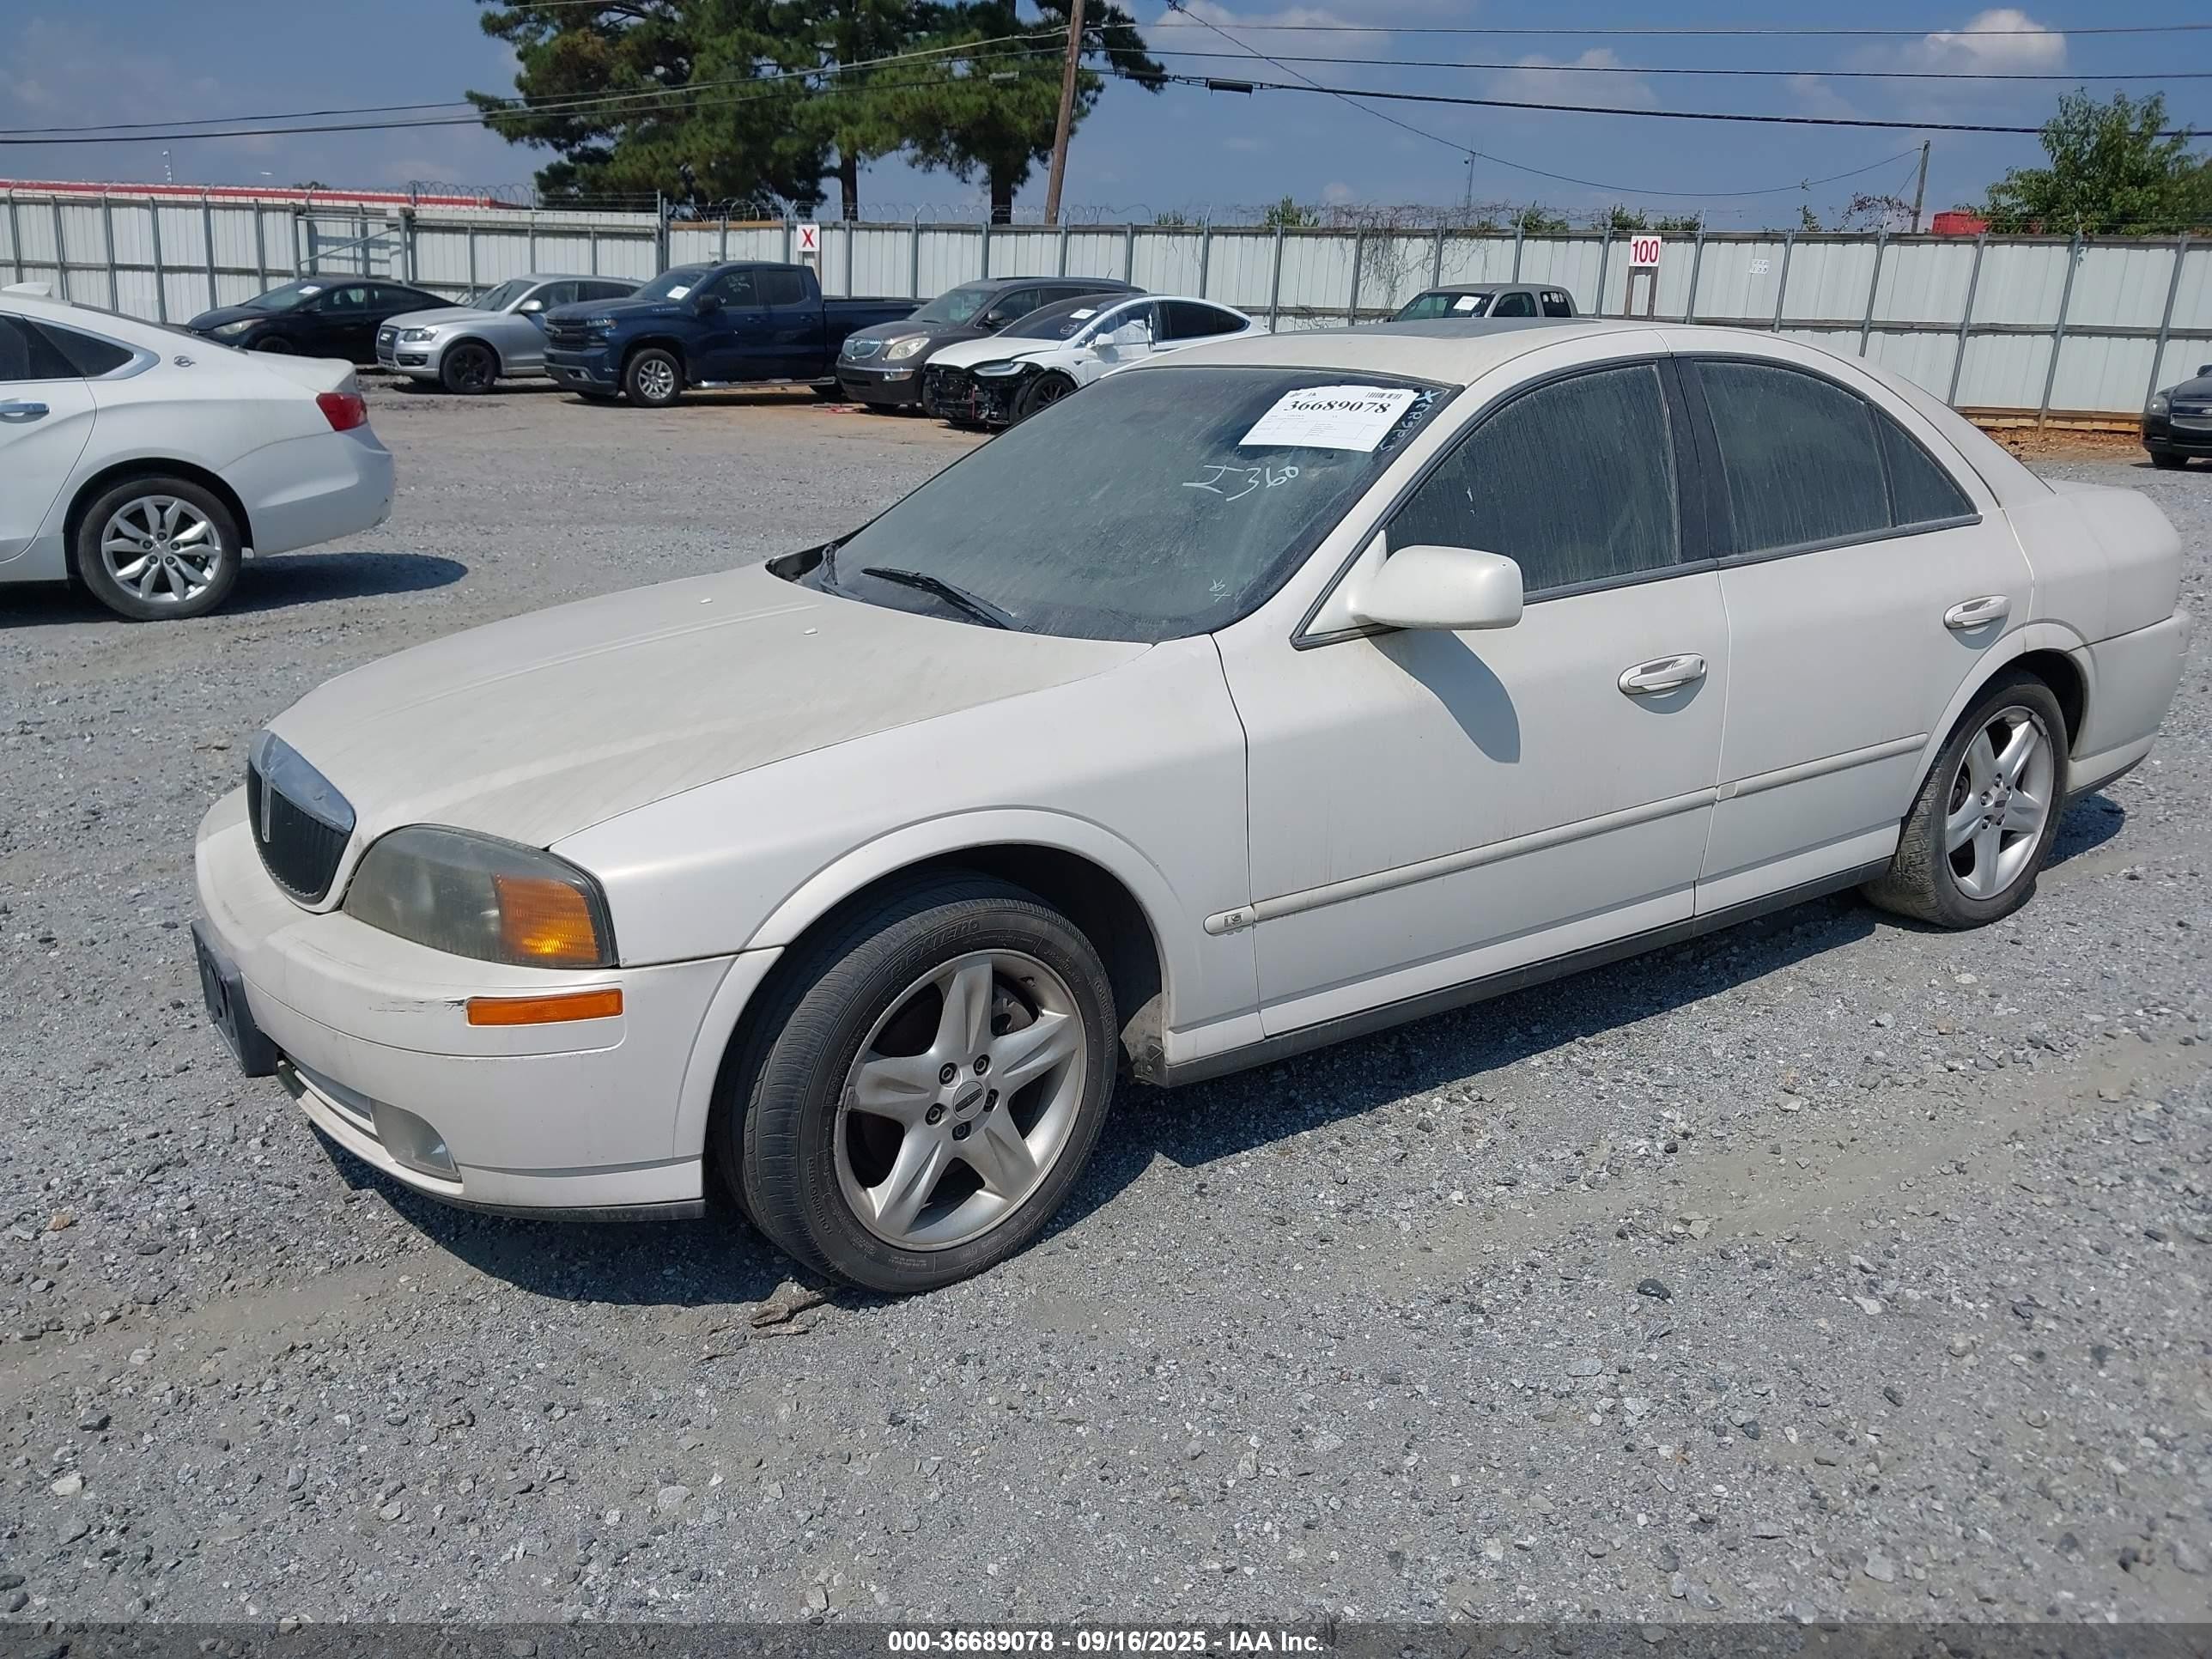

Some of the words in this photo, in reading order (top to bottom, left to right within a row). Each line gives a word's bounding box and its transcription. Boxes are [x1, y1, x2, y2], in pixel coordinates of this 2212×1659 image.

[802, 228, 814, 247] X
[1632, 240, 1659, 263] 100
[1284, 400, 1391, 414] 36689078
[810, 1186, 834, 1236] TOURING
